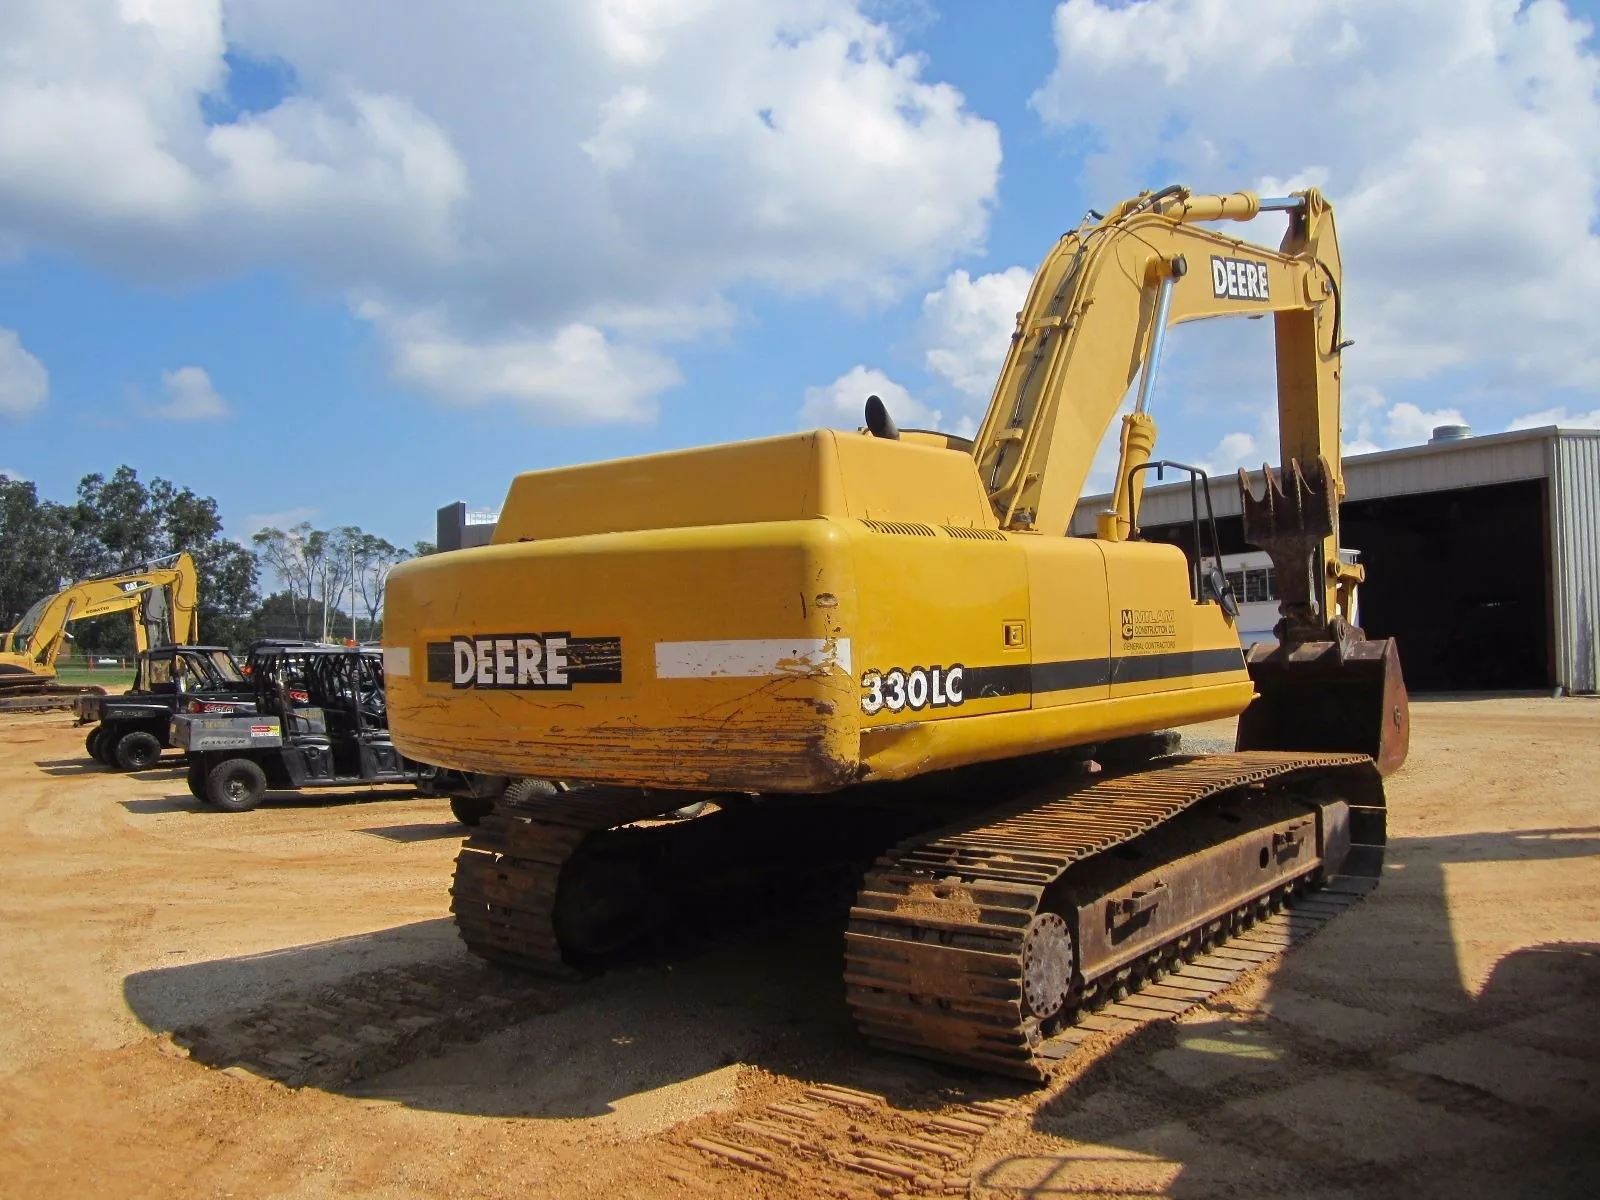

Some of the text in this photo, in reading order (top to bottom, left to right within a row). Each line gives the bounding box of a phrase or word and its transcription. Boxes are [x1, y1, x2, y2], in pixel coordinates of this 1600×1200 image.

[1212, 258, 1269, 299] DEERE
[1134, 609, 1175, 623] MILAM
[452, 638, 568, 686] DEERE
[861, 665, 964, 713] 330LC
